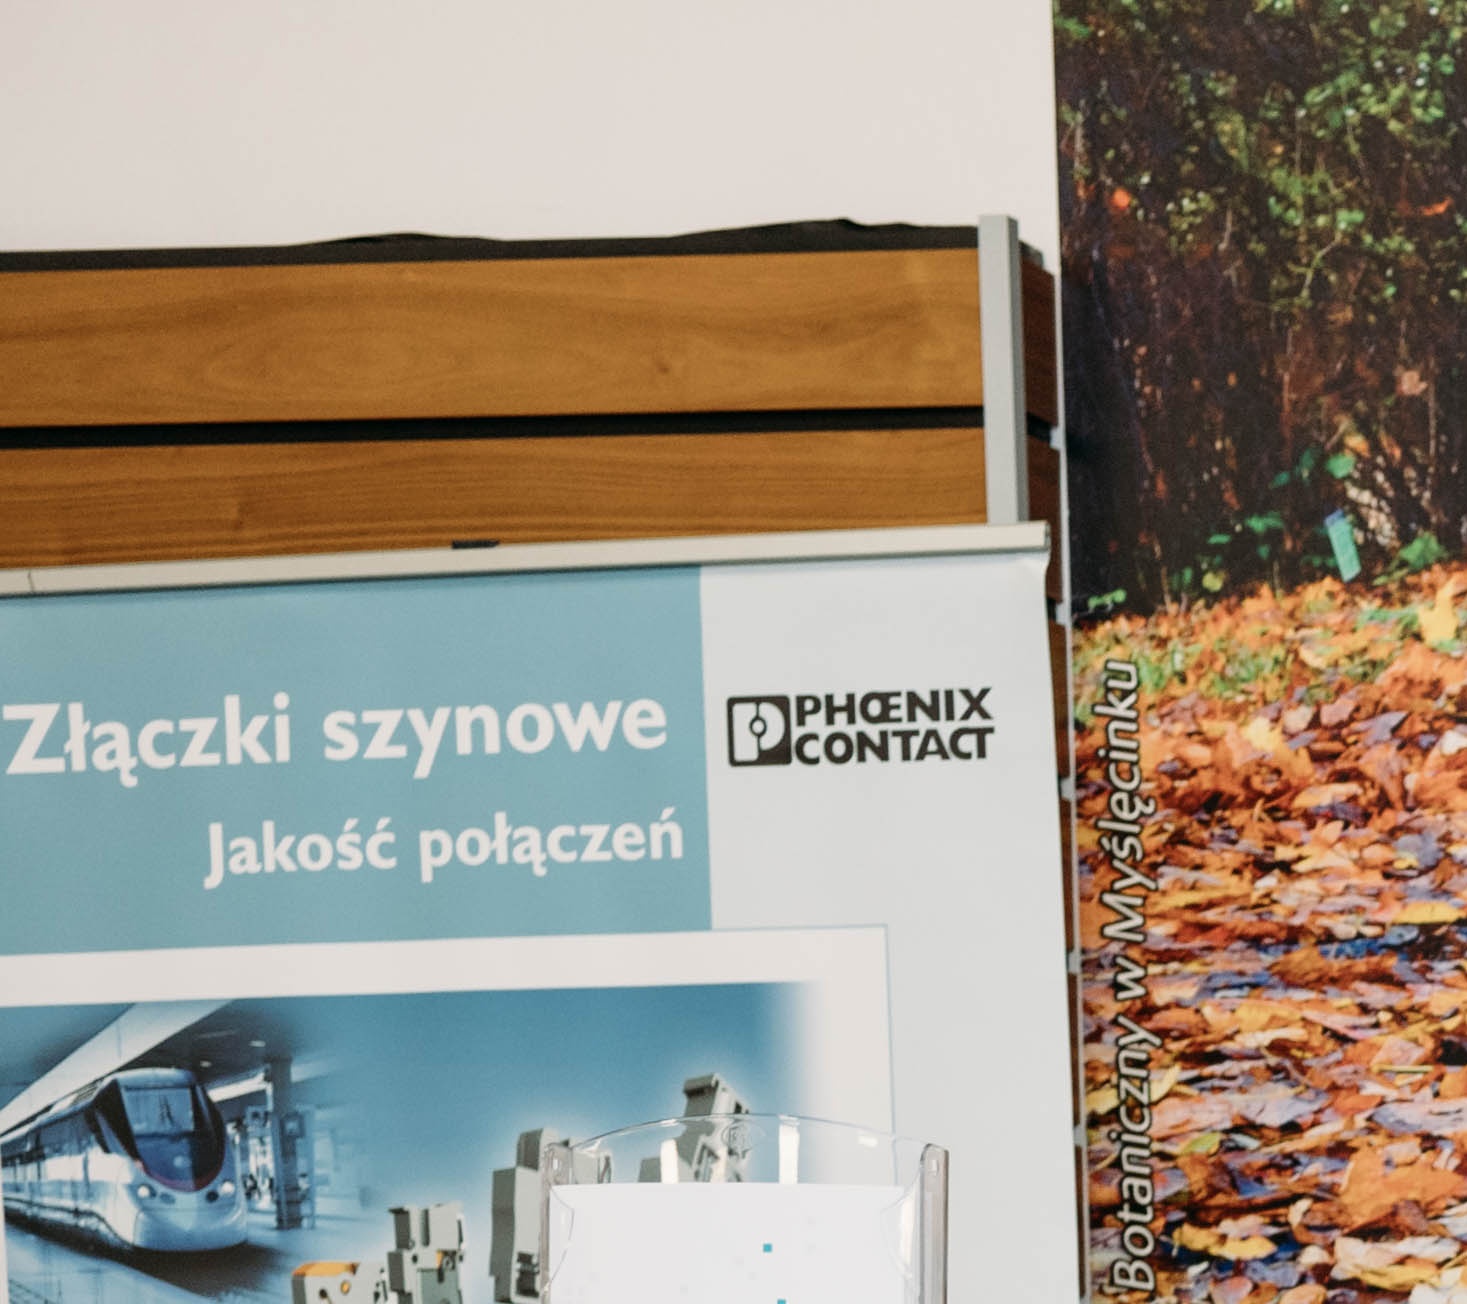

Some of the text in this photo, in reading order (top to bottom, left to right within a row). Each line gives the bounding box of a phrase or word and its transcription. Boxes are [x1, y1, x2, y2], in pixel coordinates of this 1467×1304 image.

[2, 691, 668, 787] Złączki szynowe
[794, 726, 995, 765] CONTACT
[1093, 658, 1160, 944] Myślęcinku
[202, 807, 684, 888] Jakość połączeń
[1113, 955, 1151, 1001] w
[1109, 1015, 1162, 1290] Botaniczny
